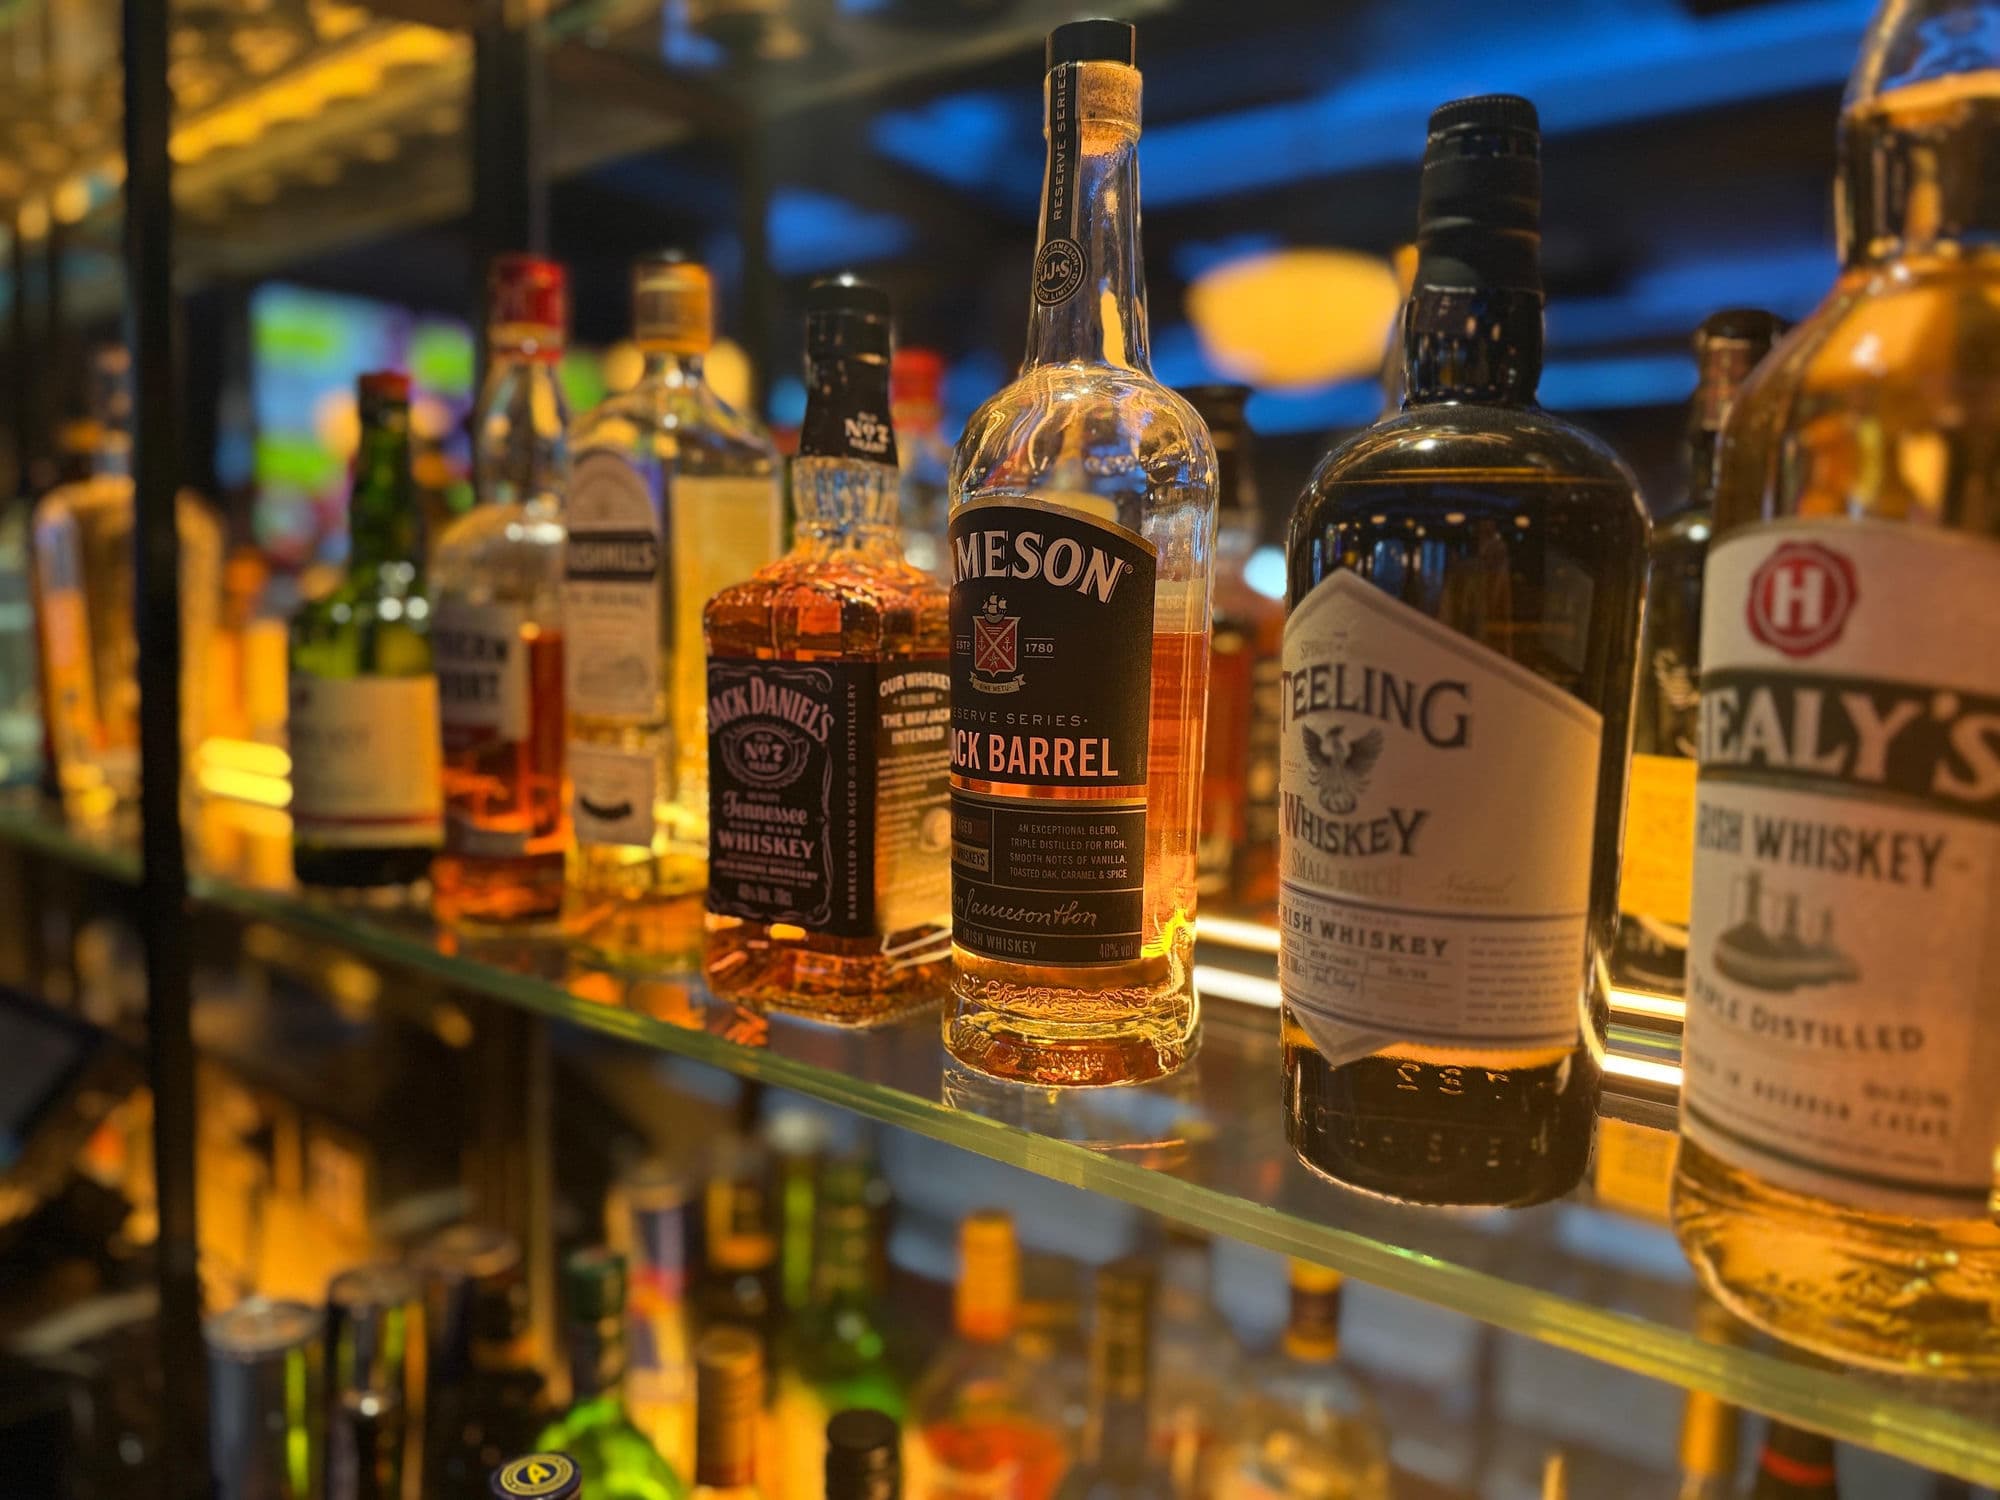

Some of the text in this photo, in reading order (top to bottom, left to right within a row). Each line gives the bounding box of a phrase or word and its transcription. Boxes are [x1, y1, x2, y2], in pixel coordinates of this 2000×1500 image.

[1053, 63, 1069, 221] RESERVE SERIES
[952, 530, 1124, 604] MESON
[1771, 565, 1826, 629] H
[1025, 643, 1054, 653] 1780
[880, 674, 905, 697] OUR
[749, 675, 834, 742] DANIEL'S
[847, 682, 857, 761] DISTILLERY
[881, 712, 903, 728] THE
[953, 706, 998, 723] ESERVE
[989, 734, 1119, 777] BARREL
[722, 789, 808, 825] Tennessee
[1283, 789, 1430, 857] WHISKEY
[717, 829, 815, 859] WHISKEY
[1011, 837, 1036, 849] TRIPLE
[1040, 840, 1082, 850] DISTILLED
[1085, 841, 1101, 850] FOR
[1018, 823, 1029, 833] AN
[1031, 824, 1087, 836] EXCEPTIONAL
[1009, 852, 1042, 863] SMOOTH
[1046, 855, 1073, 865] NOTES
[1077, 855, 1088, 865] OF
[1291, 847, 1332, 887] SMALL
[1754, 813, 1946, 890] WHISKEY
[1010, 866, 1040, 878] TOASTED
[1061, 870, 1097, 880] CARAMEL
[1099, 872, 1105, 880] &
[1106, 869, 1128, 879] SPICE
[962, 927, 1037, 954] IRISH WHISKEY
[1281, 904, 1448, 957] RISH WHISKEY
[1751, 1006, 1925, 1051] DISTILLED
[527, 1463, 551, 1485] A
